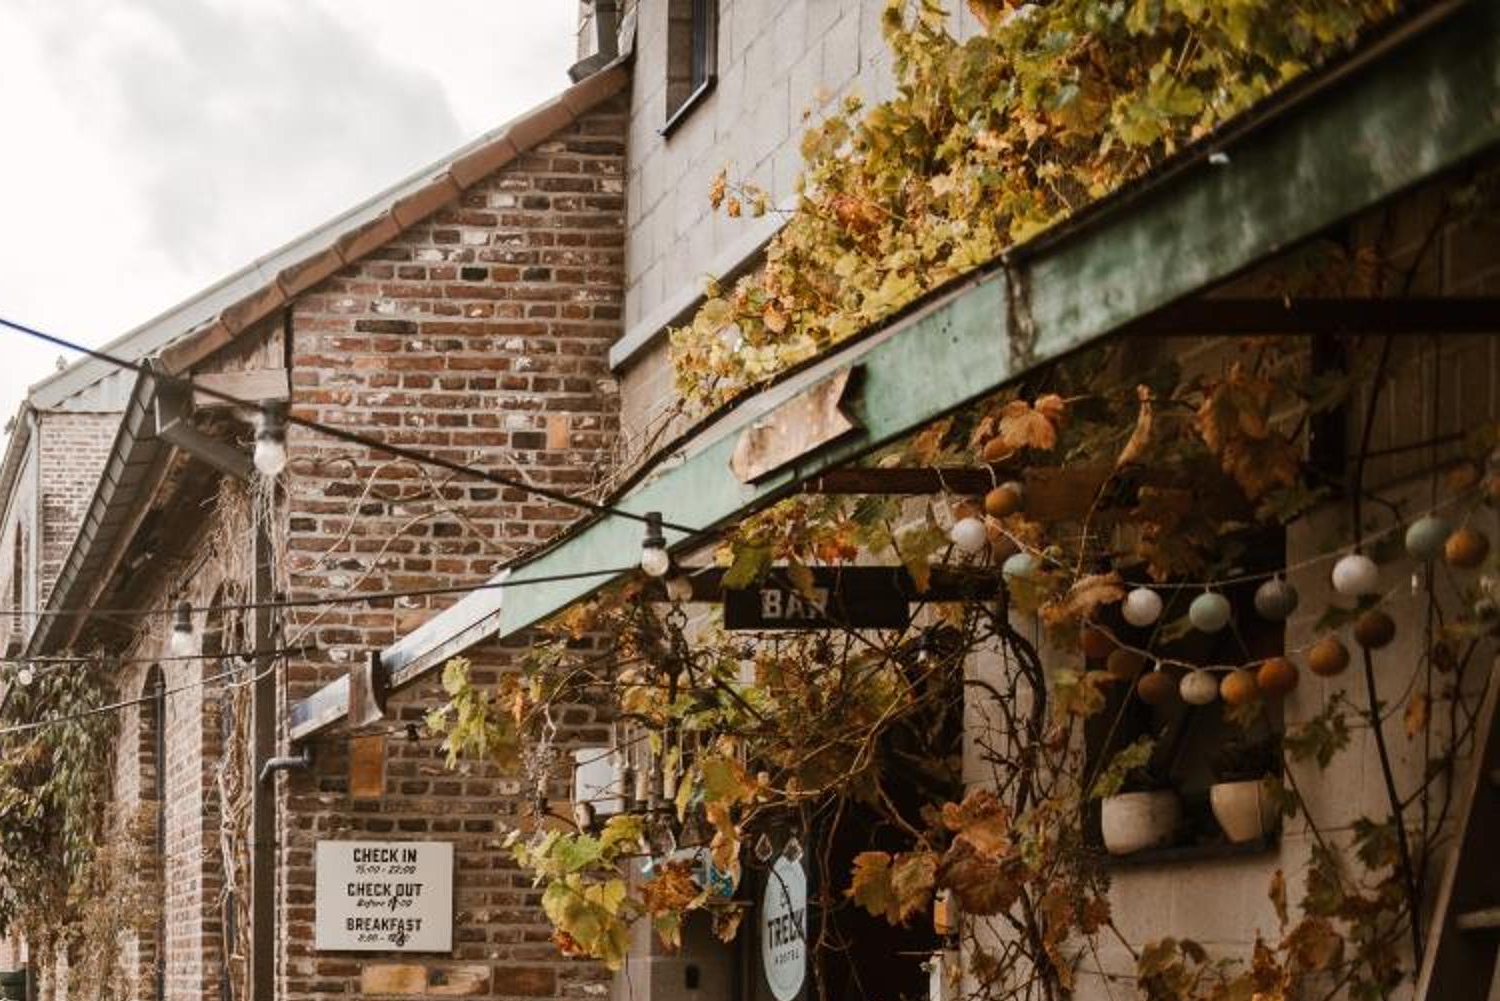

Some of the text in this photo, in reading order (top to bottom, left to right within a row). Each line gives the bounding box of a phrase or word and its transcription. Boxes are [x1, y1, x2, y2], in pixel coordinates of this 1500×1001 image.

[758, 587, 829, 620] BAR
[353, 847, 417, 863] CHECK IN
[388, 864, 417, 875] 22:00
[347, 882, 424, 897] CHECK OUT
[346, 917, 422, 932] BREAKFAST
[767, 908, 805, 950] TRECK
